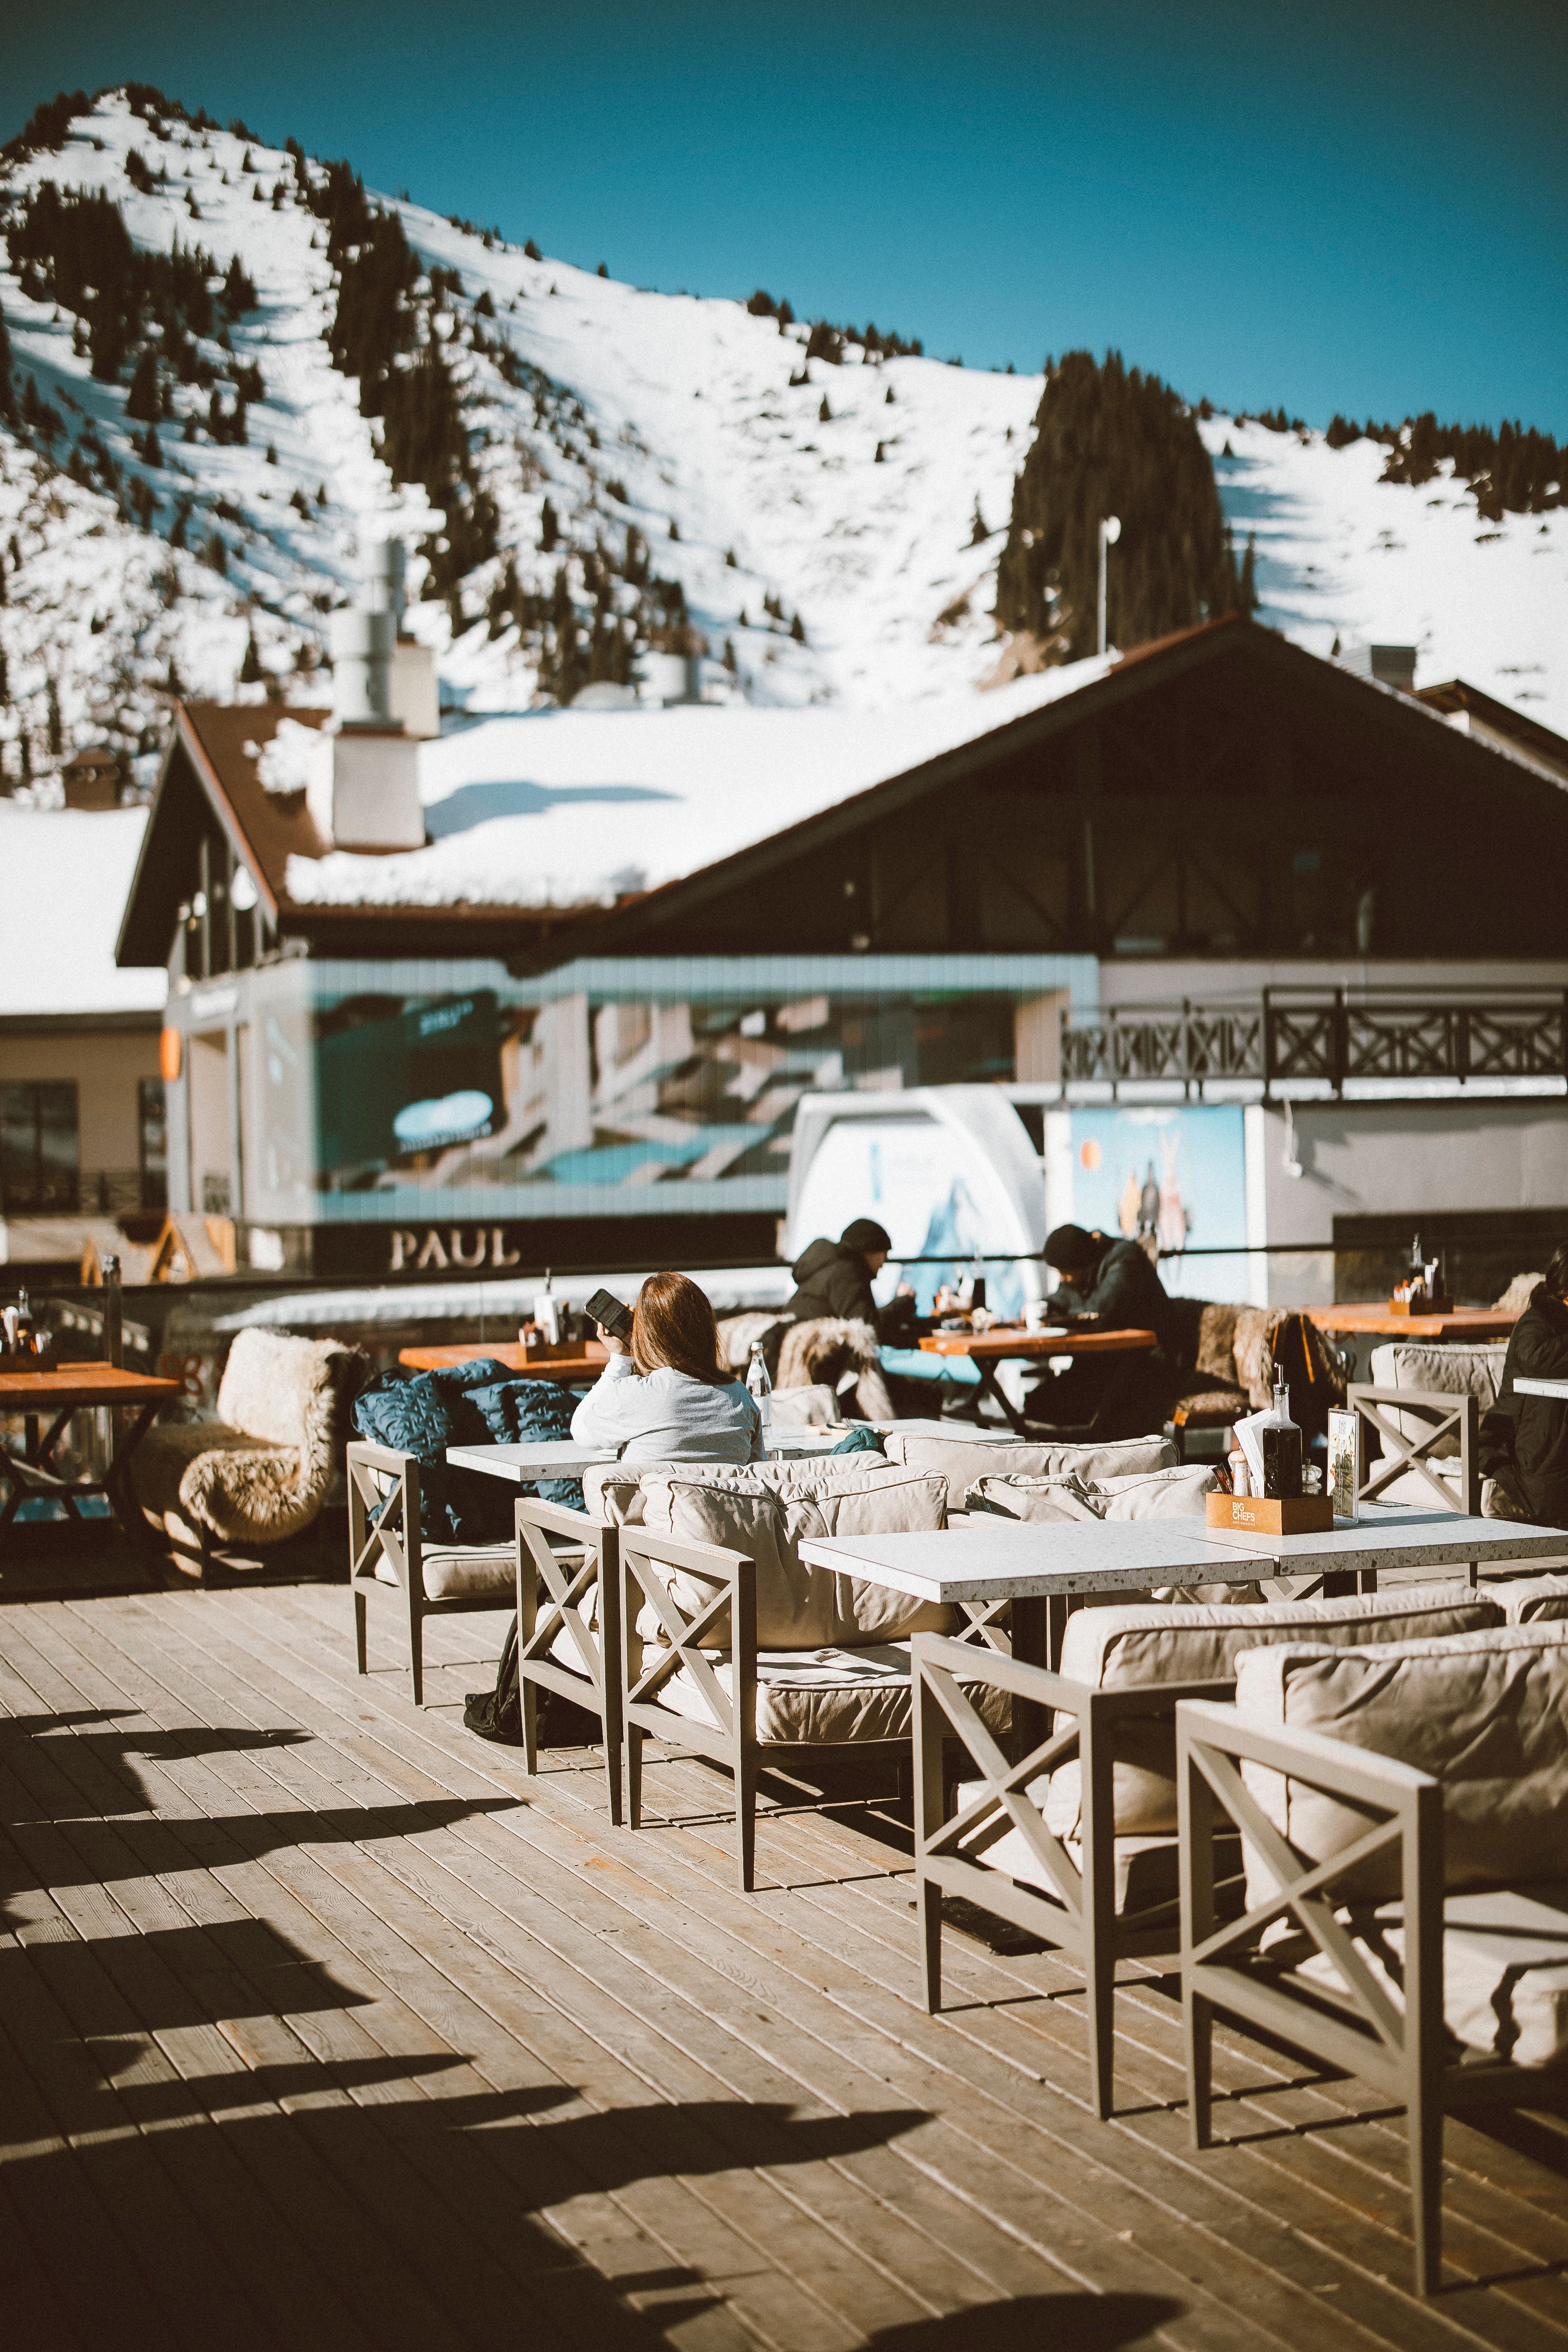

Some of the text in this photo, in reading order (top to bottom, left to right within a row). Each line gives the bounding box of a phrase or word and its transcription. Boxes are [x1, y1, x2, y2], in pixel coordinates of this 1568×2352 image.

[390, 1228, 521, 1271] PAUL
[1232, 1501, 1244, 1512] BIG
[1232, 1510, 1256, 1522] CHEFS
